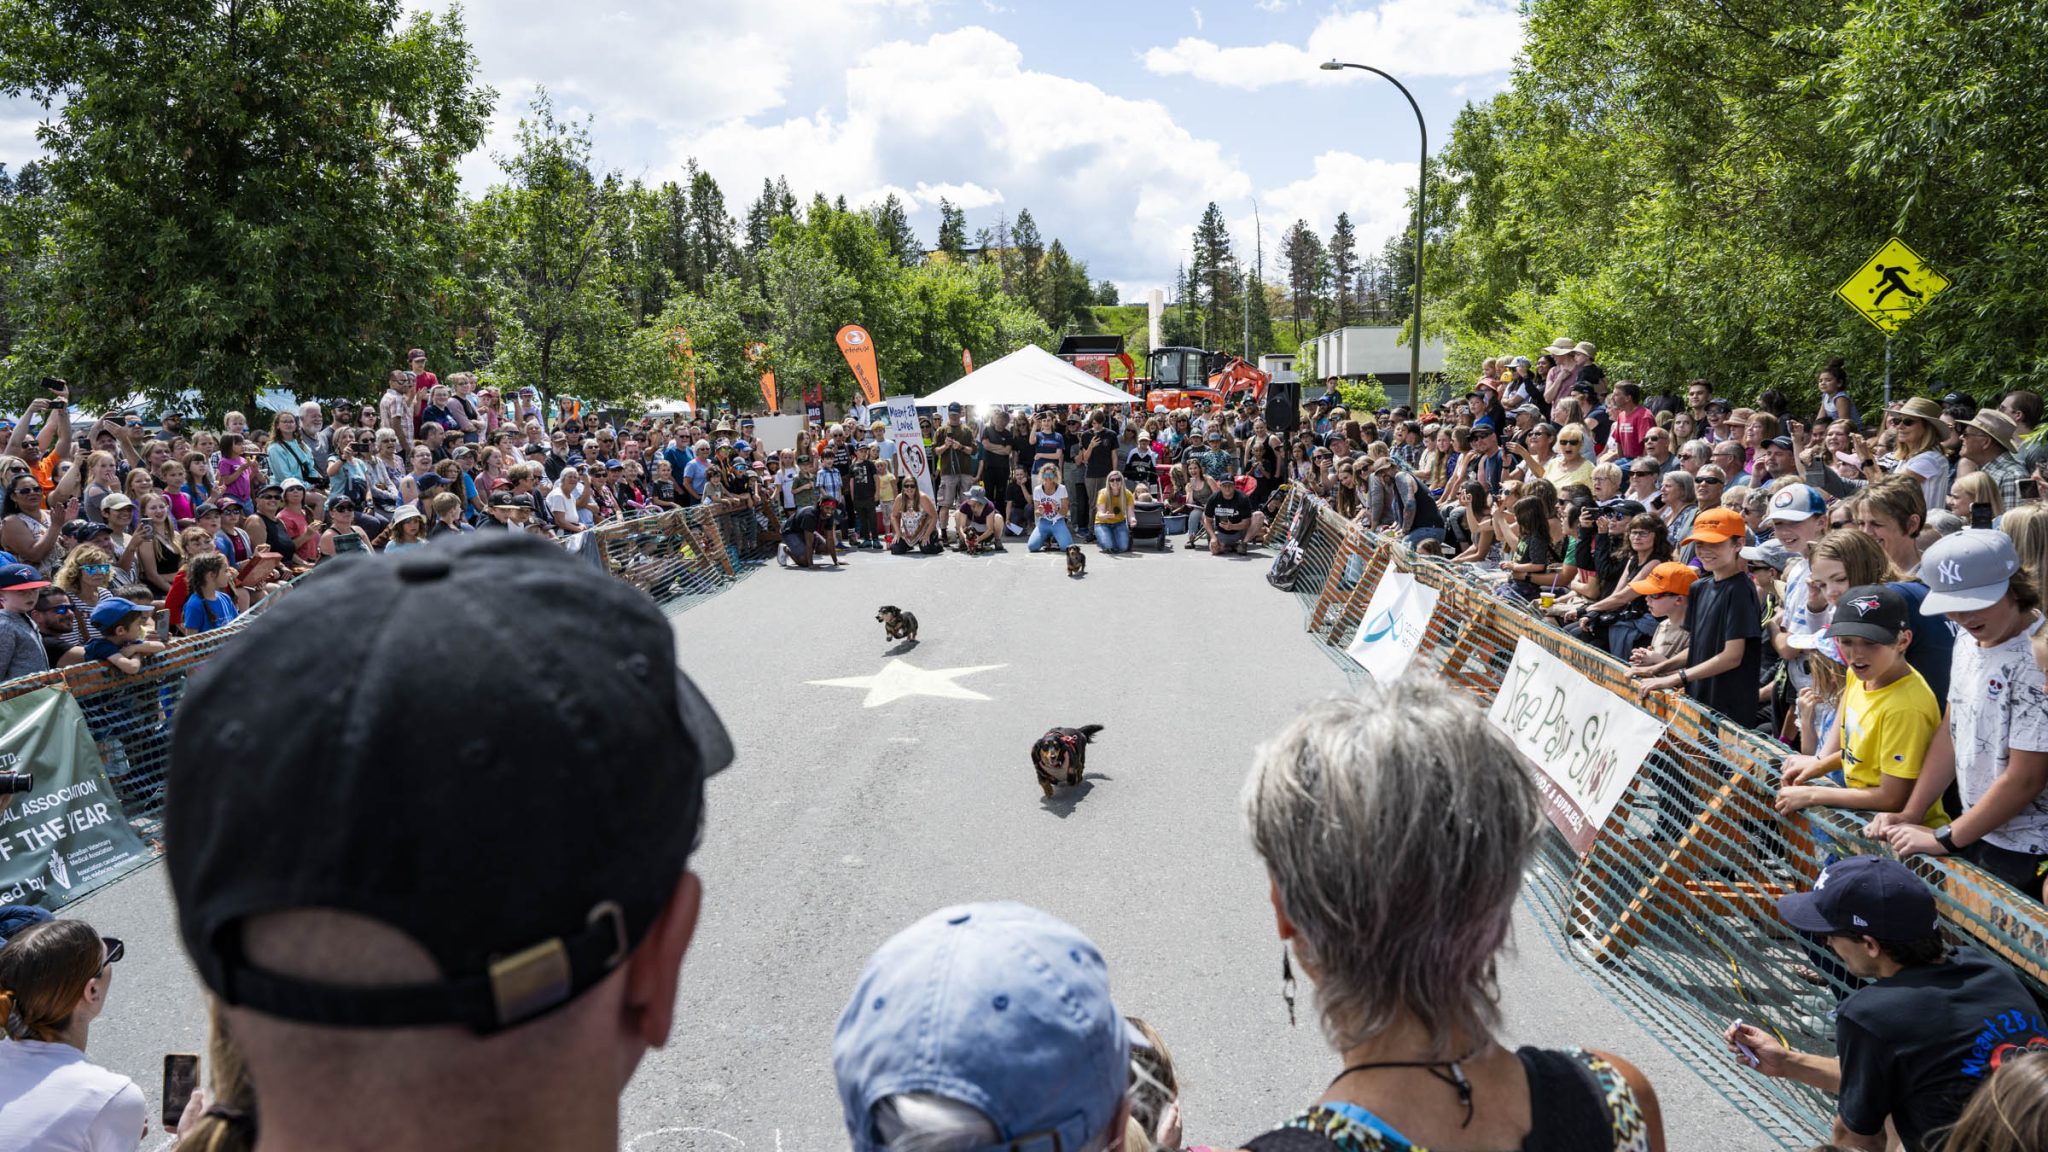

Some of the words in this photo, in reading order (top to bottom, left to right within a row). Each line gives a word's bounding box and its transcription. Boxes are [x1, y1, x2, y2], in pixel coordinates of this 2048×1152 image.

[889, 406, 908, 420] Meant
[896, 420, 914, 431] Loved
[1938, 560, 1963, 584] NY
[1502, 661, 1542, 735] The
[1528, 686, 1574, 762] Paw
[0, 752, 21, 768] TD.
[21, 779, 98, 817] ASSOCIATION
[15, 817, 67, 851] THE
[66, 803, 112, 834] YEAR
[0, 882, 25, 906] ed
[25, 876, 46, 891] by
[1960, 1018, 2005, 1078] Meant
